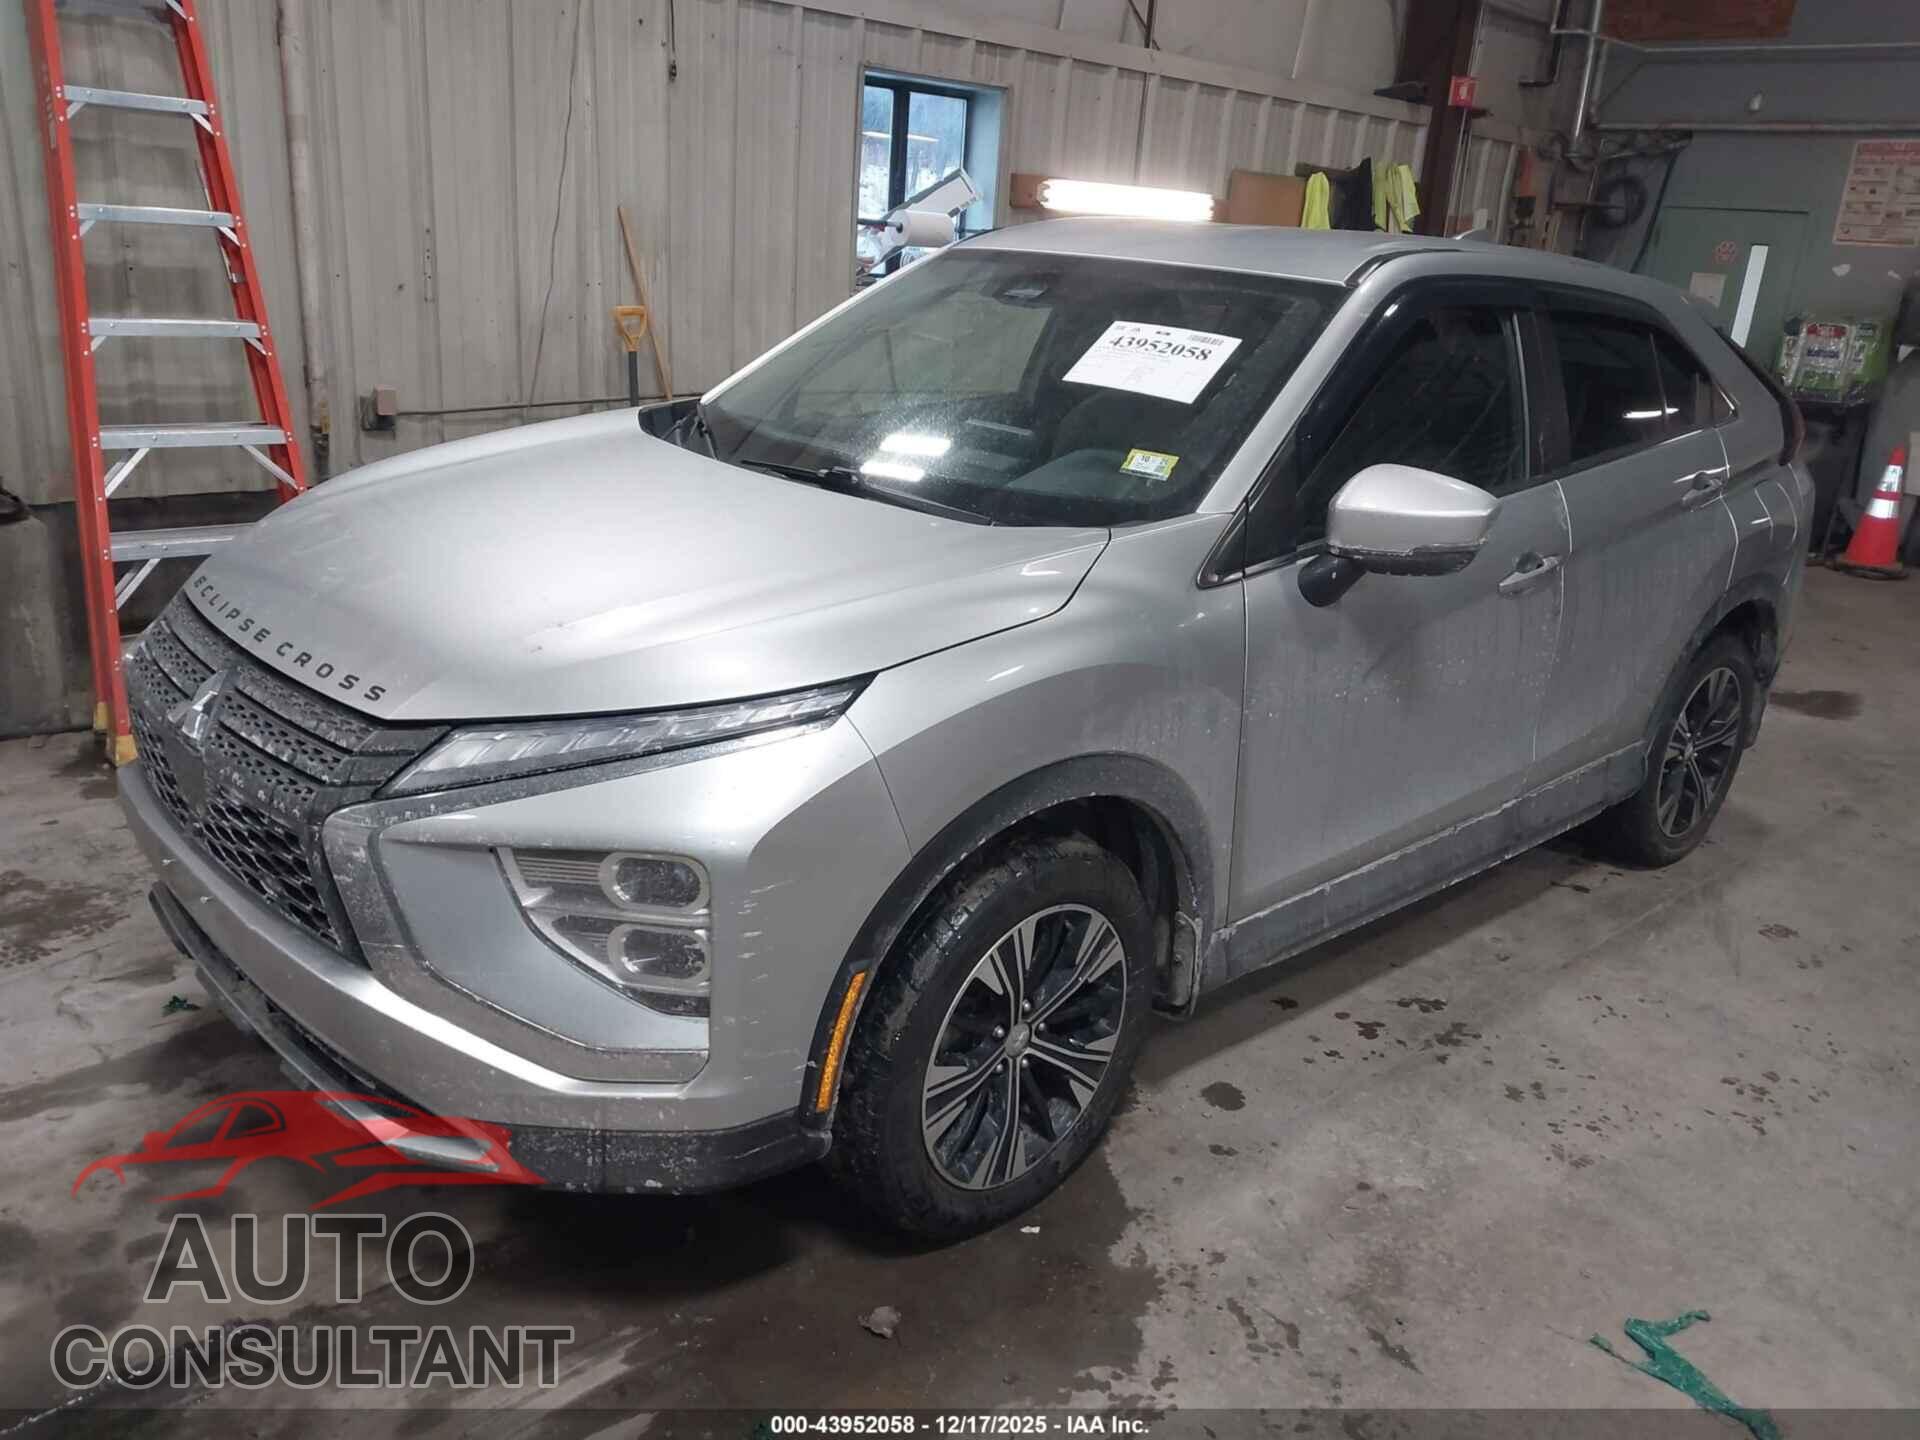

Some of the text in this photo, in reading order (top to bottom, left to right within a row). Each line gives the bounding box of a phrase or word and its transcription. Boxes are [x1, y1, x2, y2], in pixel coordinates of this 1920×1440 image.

[1110, 335, 1212, 361] 43952058
[194, 575, 386, 702] ECLIPSE CROSS
